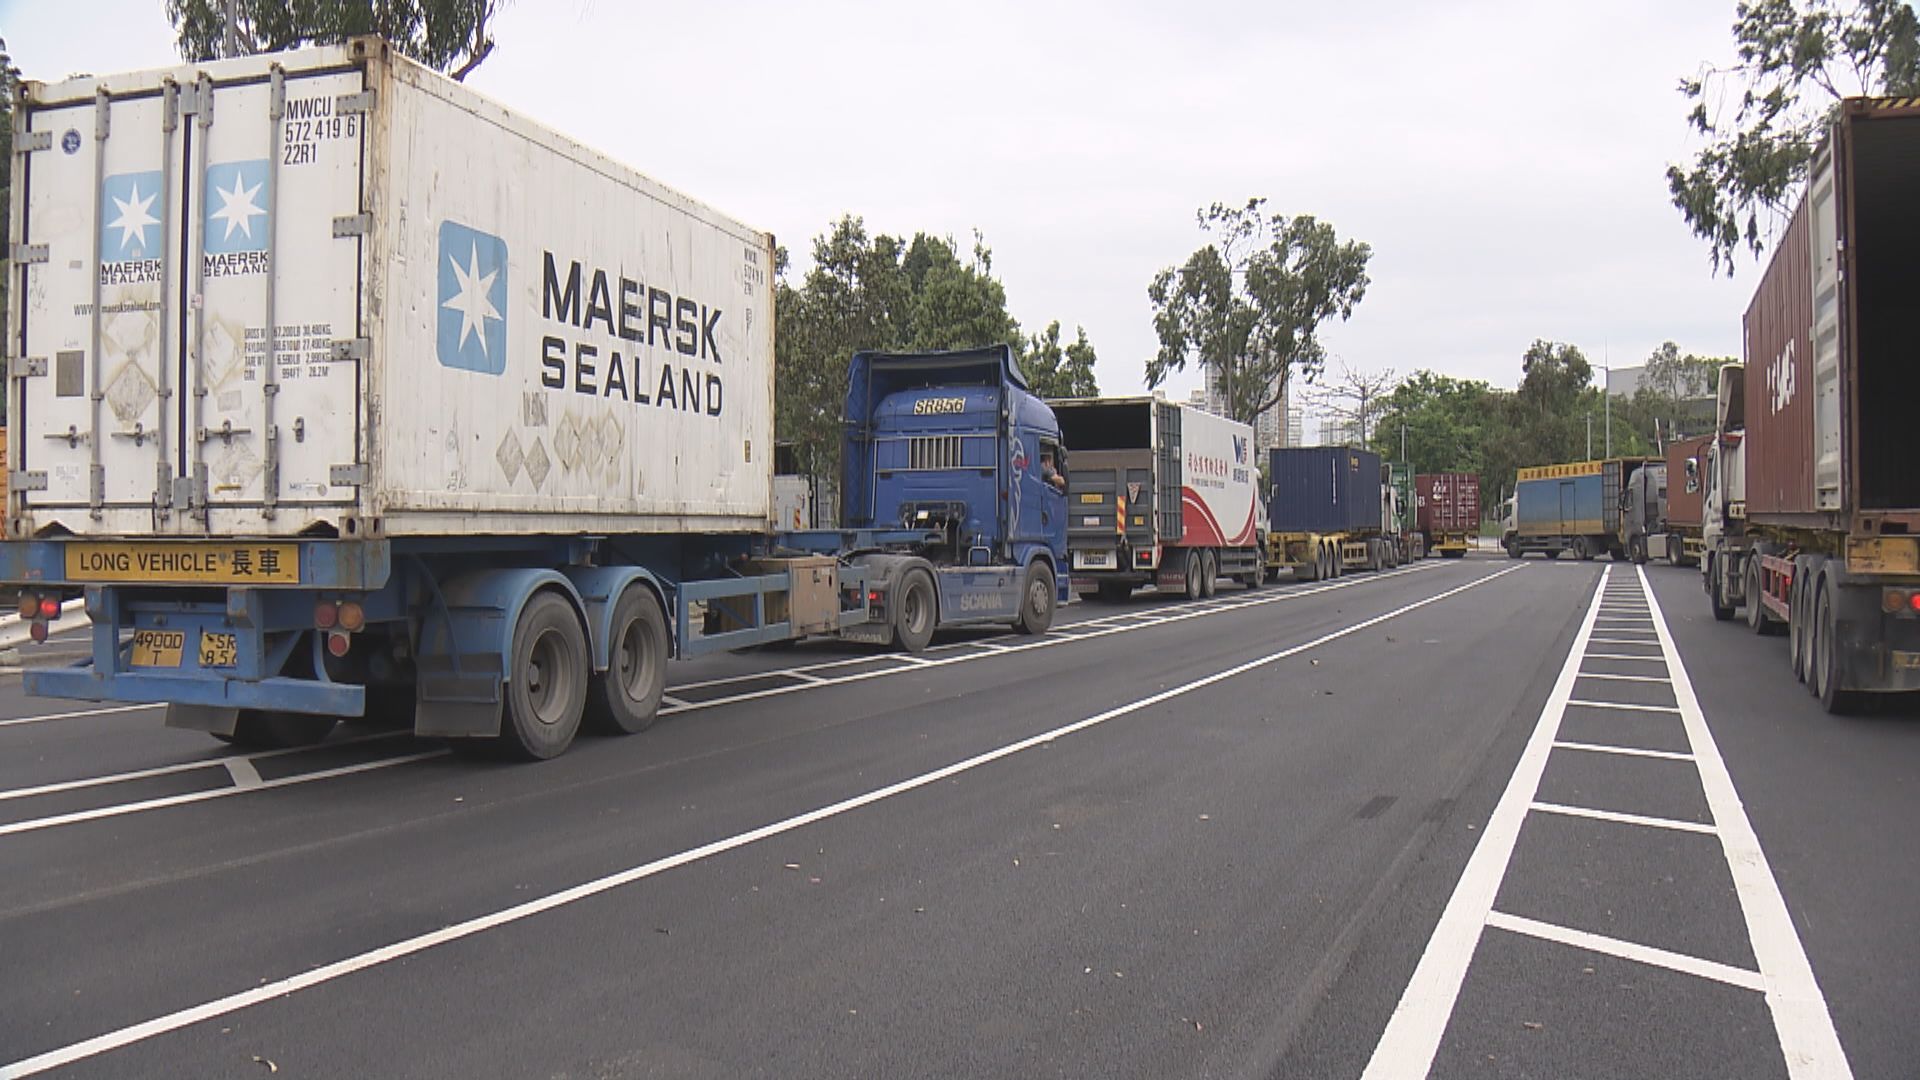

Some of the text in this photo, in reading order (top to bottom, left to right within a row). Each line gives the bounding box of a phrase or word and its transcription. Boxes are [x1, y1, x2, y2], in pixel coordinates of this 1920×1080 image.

[287, 96, 331, 120] MWCU
[285, 116, 356, 143] 572 419 6
[284, 142, 317, 165] 22R1
[101, 259, 161, 275] MAERSK
[204, 252, 268, 267] MAERSK
[543, 250, 722, 364] MAERSK
[541, 335, 723, 417] SEALAND
[915, 399, 964, 414] SR856
[81, 548, 281, 577] LONG VEHICLE 長車
[960, 592, 1002, 611] SCANIA
[153, 650, 162, 665] T
